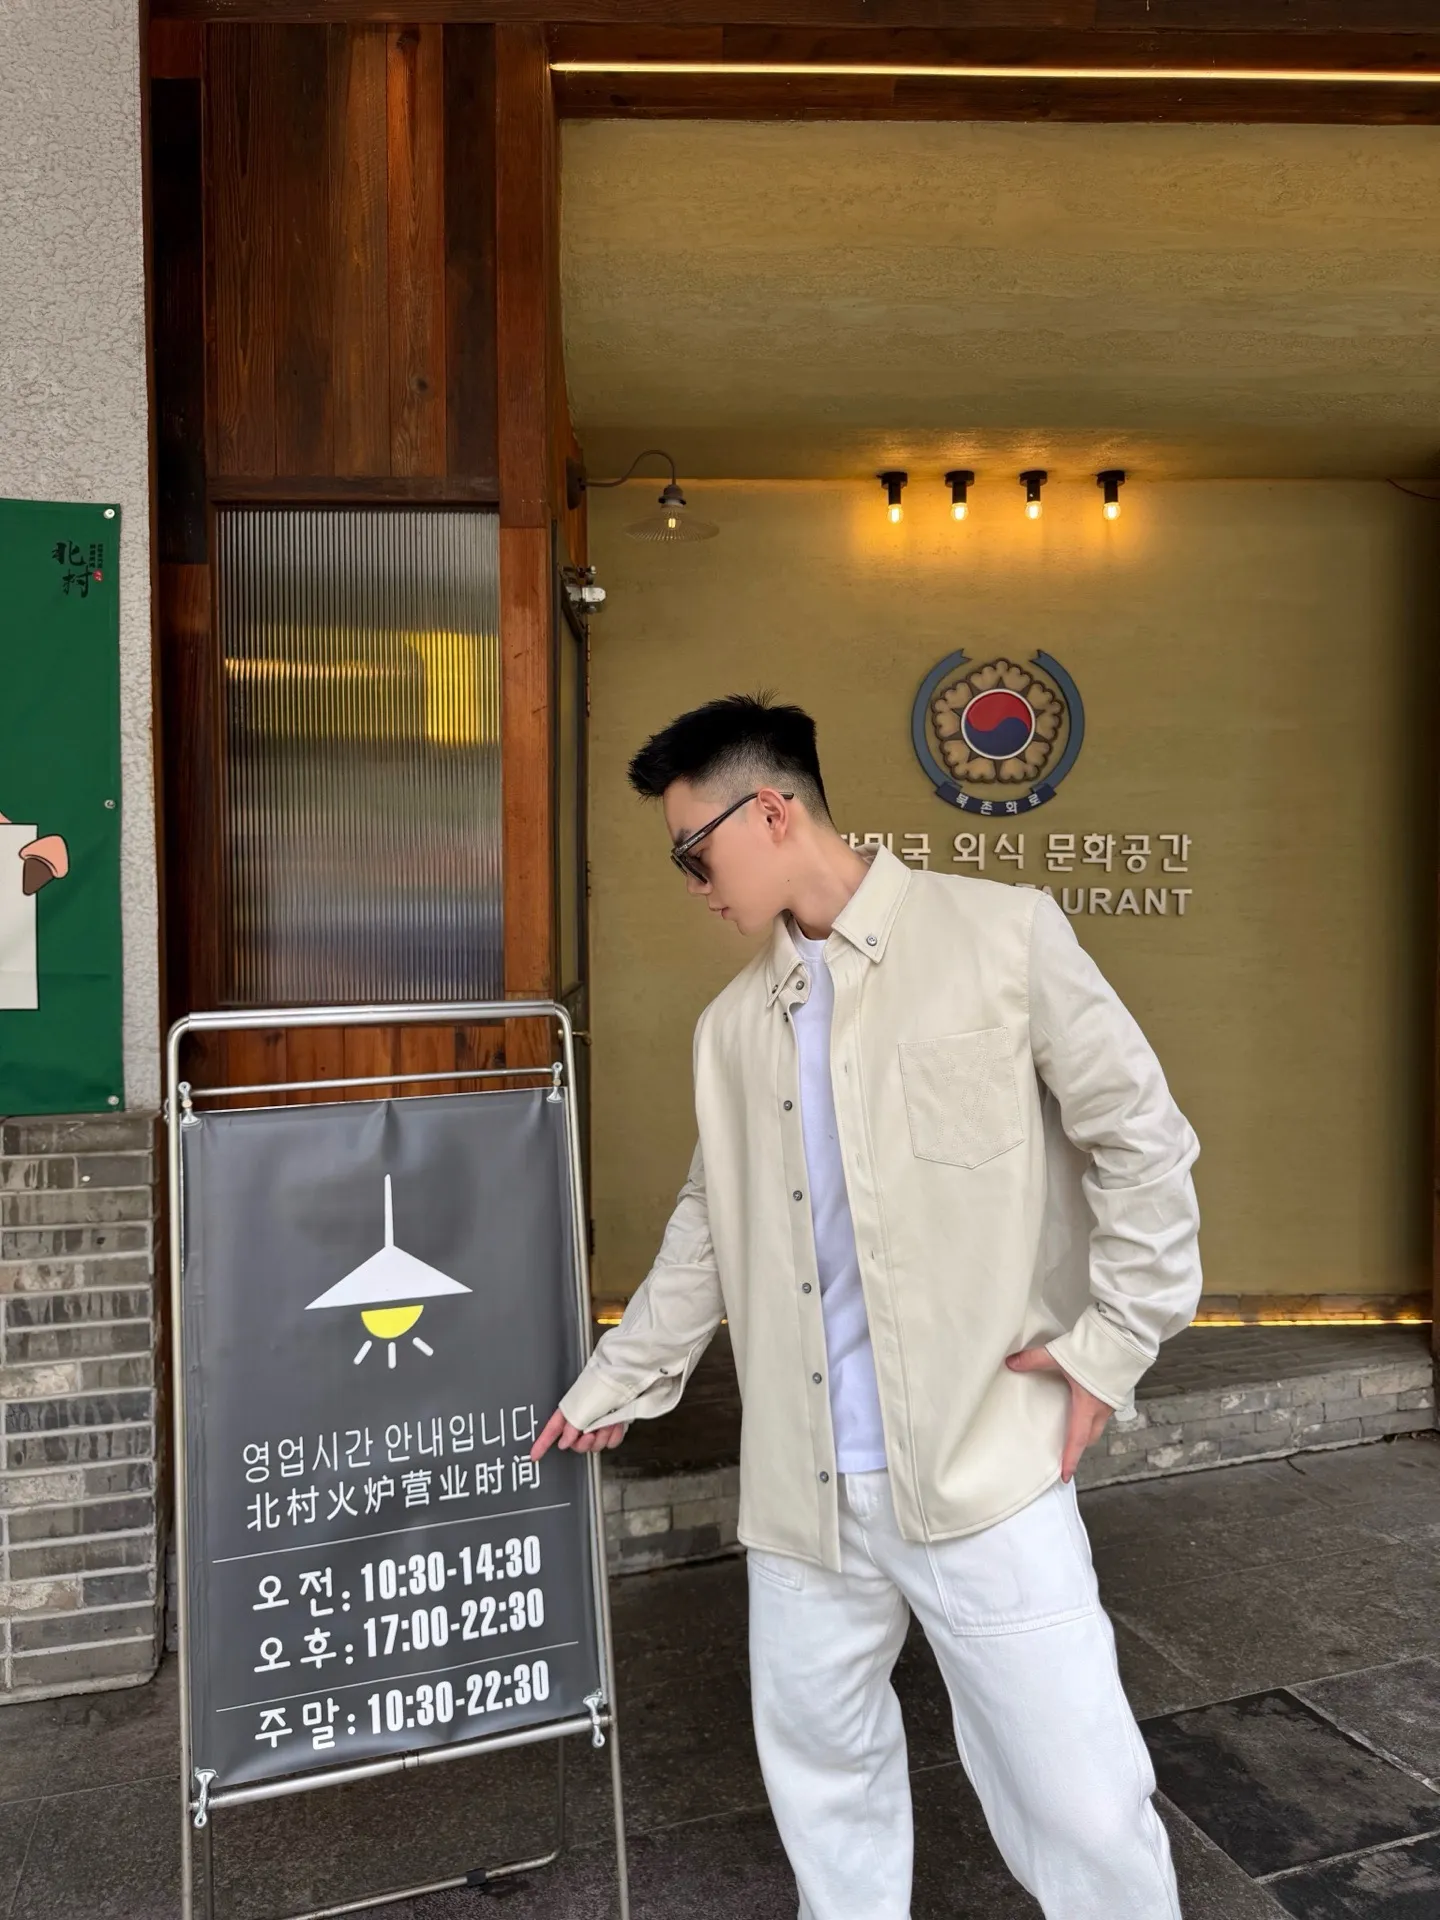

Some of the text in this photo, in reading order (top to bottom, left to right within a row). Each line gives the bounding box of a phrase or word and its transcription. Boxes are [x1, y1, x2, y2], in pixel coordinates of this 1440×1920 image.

[953, 832, 1025, 871] 외식
[1046, 832, 1192, 873] 문화공간
[242, 1404, 539, 1483] 영업시간 안내입니다
[245, 1453, 541, 1532] 北村火炉营业时间
[360, 1535, 542, 1602] 10:30-14:30
[363, 1587, 546, 1658] 17:00-22:30
[367, 1660, 550, 1735] 10:30-22:30
